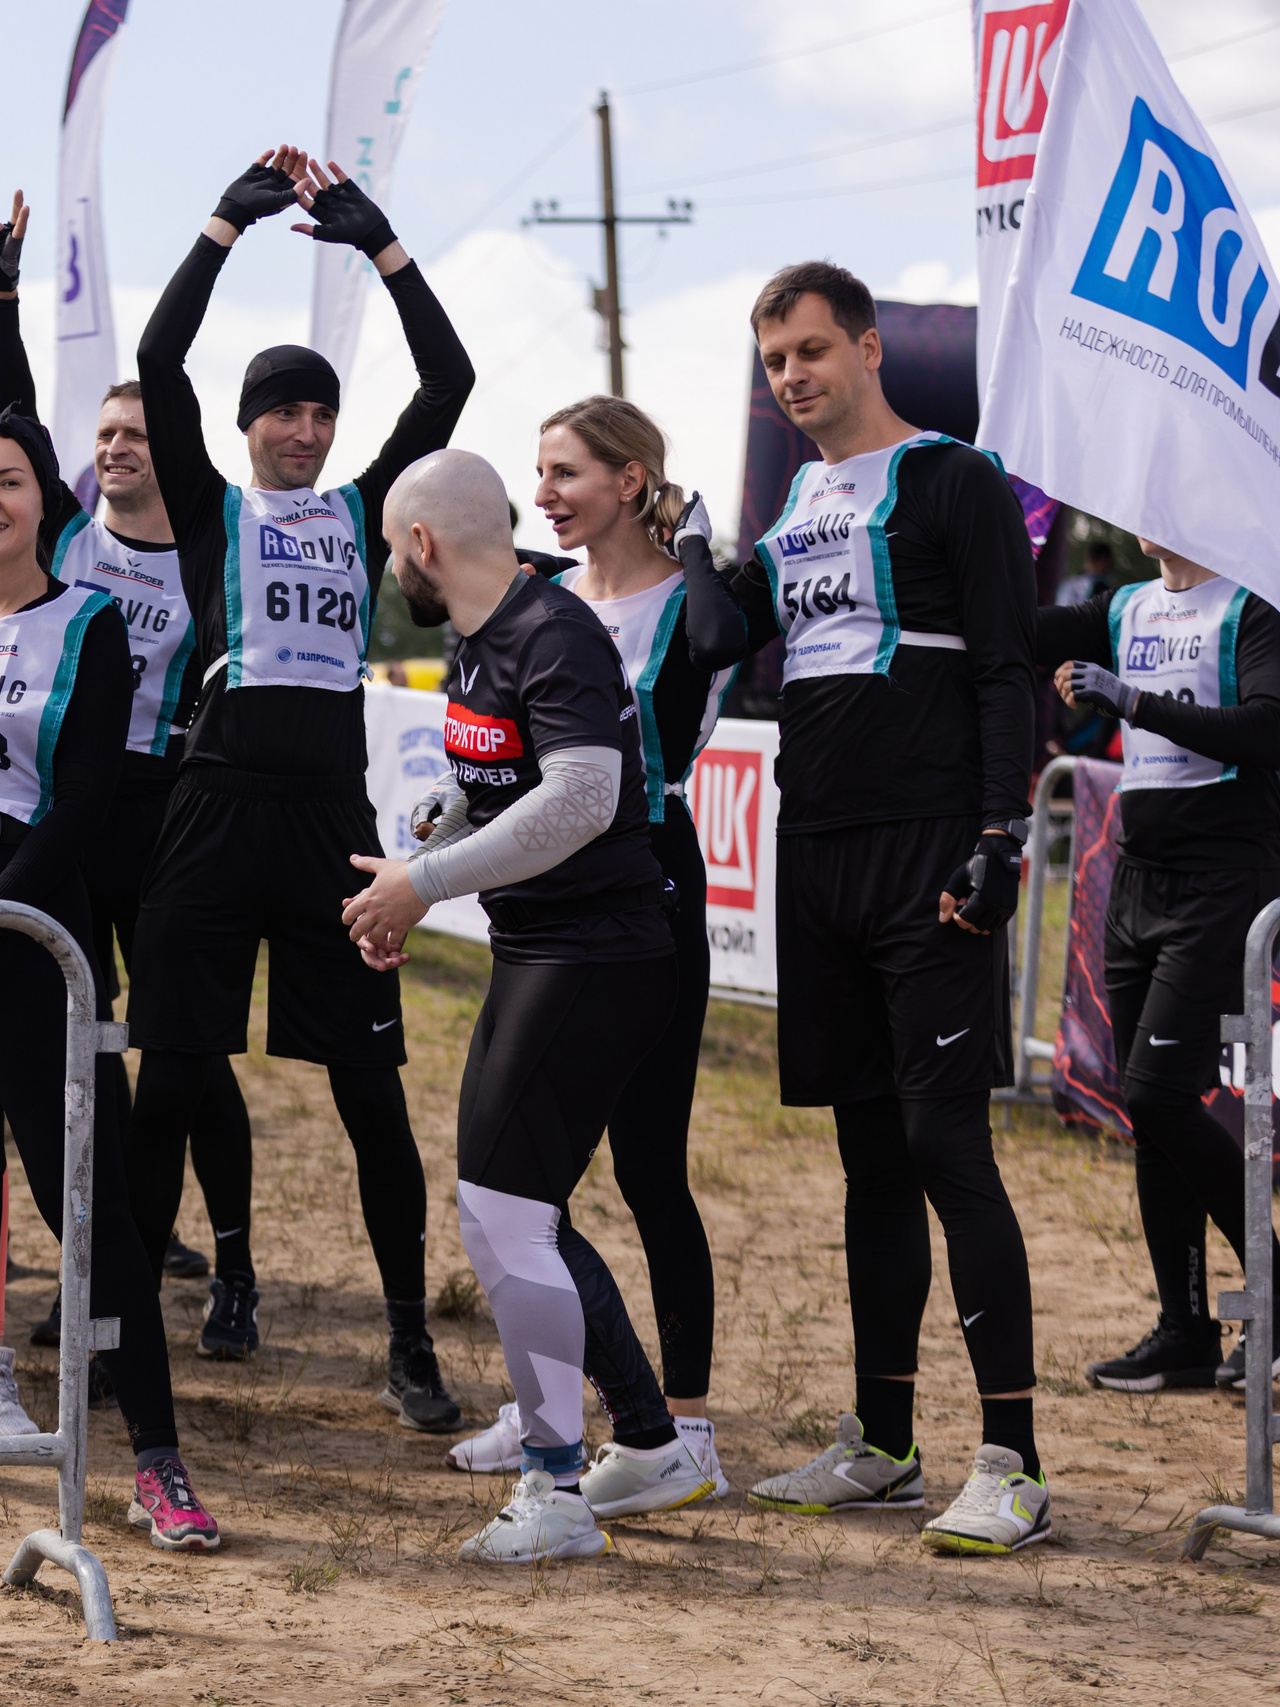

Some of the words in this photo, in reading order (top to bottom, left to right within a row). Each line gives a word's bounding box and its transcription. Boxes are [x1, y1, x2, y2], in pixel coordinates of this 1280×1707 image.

[1059, 316, 1169, 379] НАДЕЖНОСТЬ
[1170, 365, 1207, 398] ДЛЯ
[275, 511, 301, 523] ОНКА
[264, 529, 357, 571] RODVIG
[97, 561, 126, 576] ГОНКА
[128, 570, 164, 587] ГЕРОЕВ
[266, 581, 357, 632] 6120
[783, 572, 857, 622] 5164
[297, 651, 346, 669] ГАЗПРОМБАНК
[1128, 634, 1202, 668] RODVIG
[459, 762, 518, 786] ГЕРОЕВ
